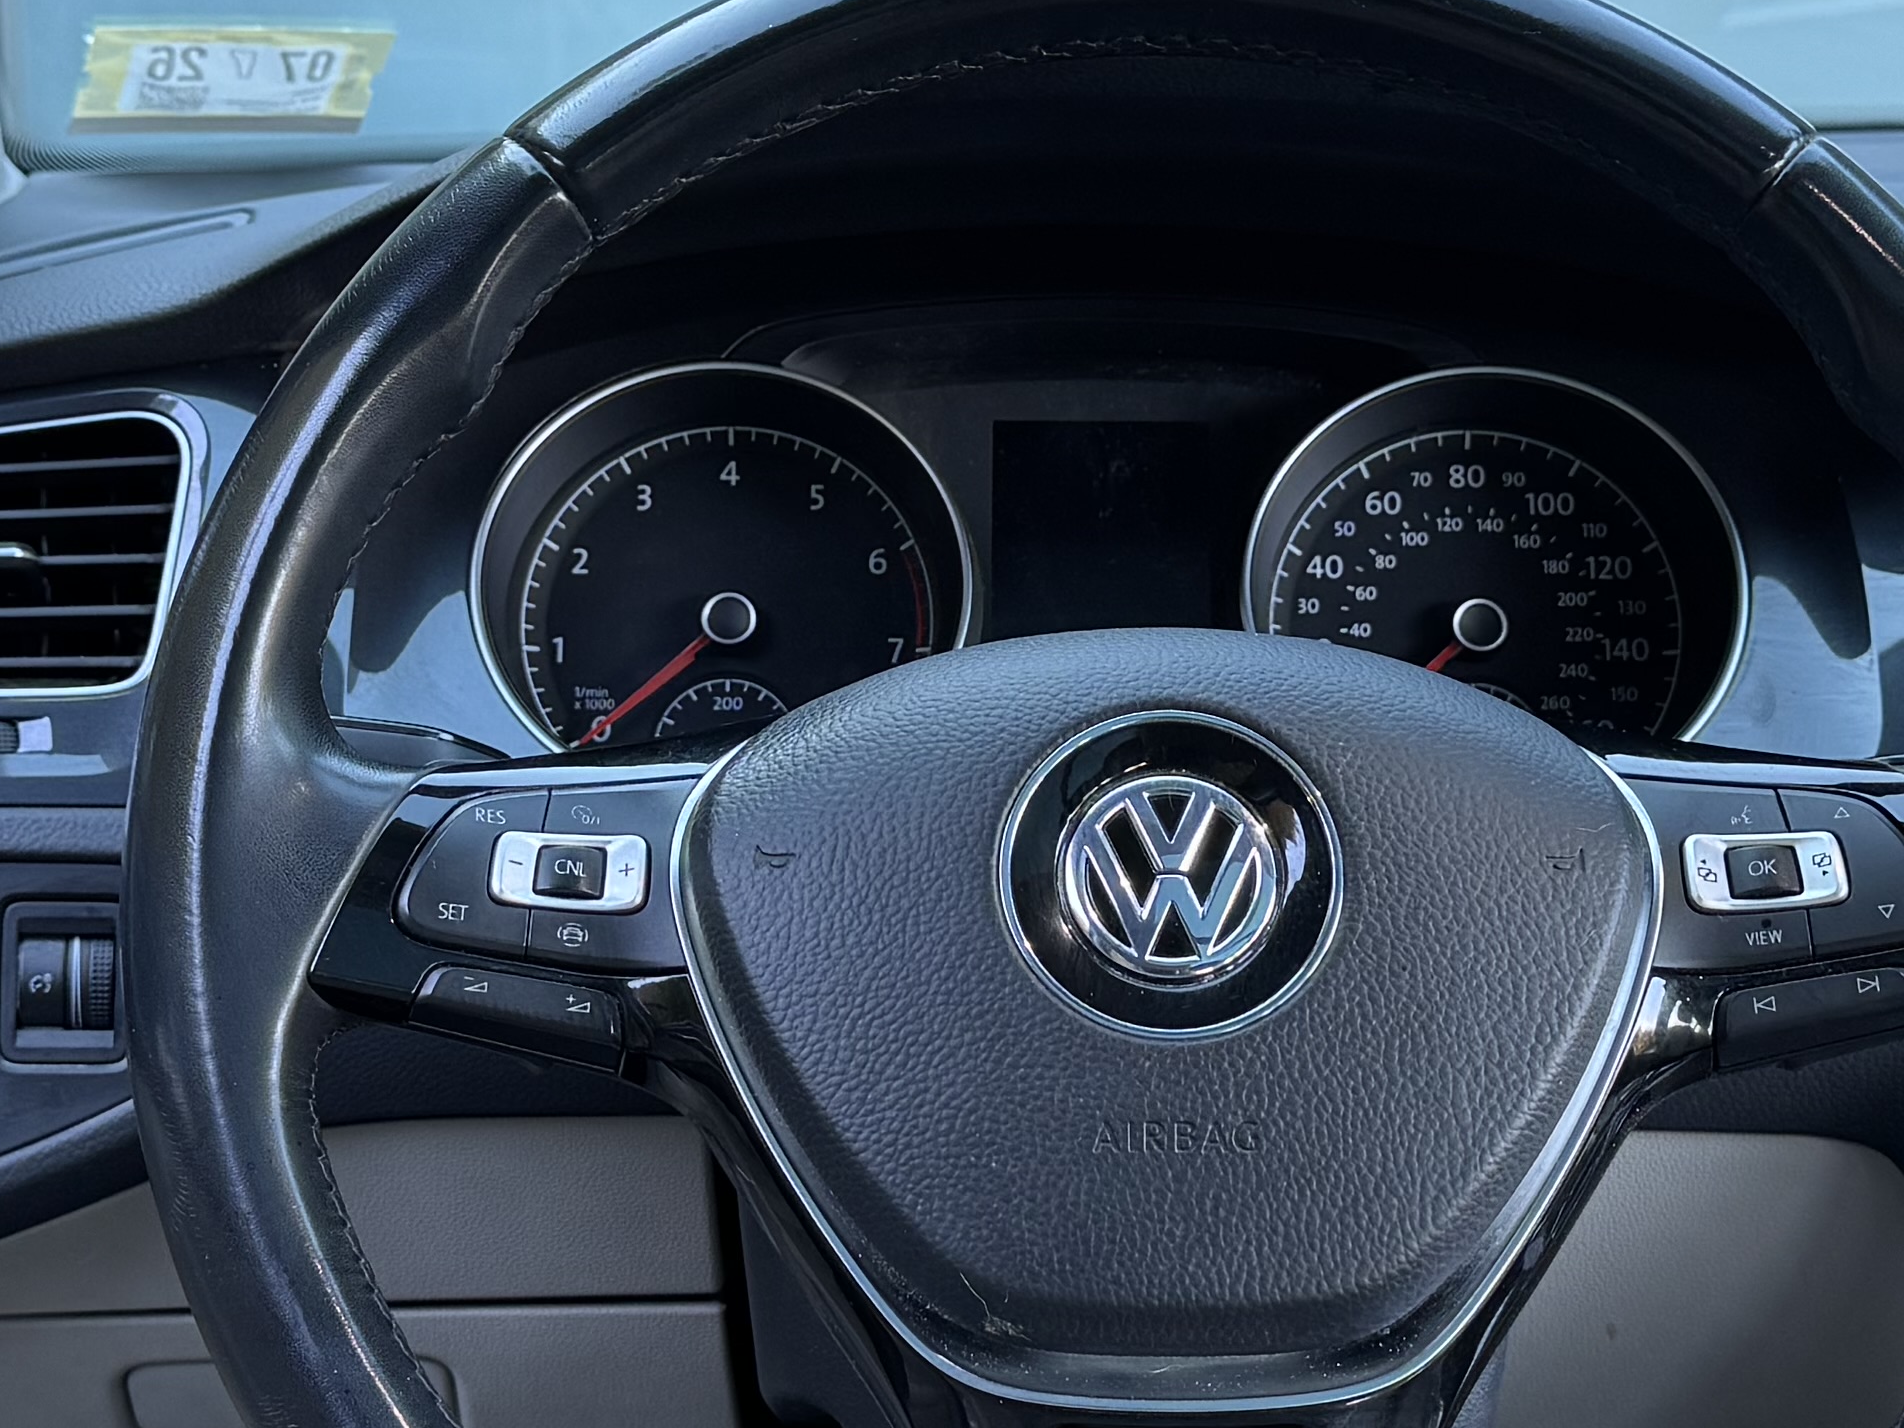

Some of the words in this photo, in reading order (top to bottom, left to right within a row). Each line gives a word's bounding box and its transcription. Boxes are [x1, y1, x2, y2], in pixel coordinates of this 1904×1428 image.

[720, 461, 740, 485] 4
[1410, 472, 1432, 487] 70
[1449, 465, 1485, 488] 80
[1502, 472, 1526, 487] 90
[636, 485, 652, 511] 3
[810, 485, 825, 510] 5
[1365, 491, 1402, 515] 60
[1524, 492, 1575, 516] 100
[1334, 521, 1356, 536] 50
[1436, 517, 1463, 532] 120
[1476, 518, 1504, 532] 140
[1581, 522, 1608, 538] 110
[1400, 531, 1429, 546] 100
[1512, 534, 1541, 549] 160
[572, 548, 589, 574] 2
[869, 549, 887, 573] 6
[1306, 554, 1344, 579] 40
[1375, 554, 1397, 569] 80
[1542, 559, 1569, 574] 180
[1585, 556, 1633, 580] 120
[1355, 585, 1377, 601] 60
[1557, 592, 1588, 607] 200
[1297, 598, 1320, 614] 30
[1618, 600, 1646, 615] 130
[1349, 623, 1371, 638] 40
[1565, 626, 1594, 642] 220
[552, 638, 564, 662] 1
[888, 639, 904, 663] 7
[1600, 637, 1649, 661] 140
[1559, 663, 1588, 678] 240
[575, 686, 609, 697] 1/min
[1611, 686, 1638, 702] 150
[585, 698, 615, 710] 1000
[713, 696, 743, 710] 200
[1540, 695, 1571, 710] 260
[592, 716, 611, 742] 0
[475, 807, 507, 826] RES
[554, 859, 587, 877] CNL
[1748, 858, 1778, 877] OK
[438, 903, 469, 922] SET
[1744, 929, 1783, 946] VIEW
[1093, 1121, 1262, 1154] AIRBAG
